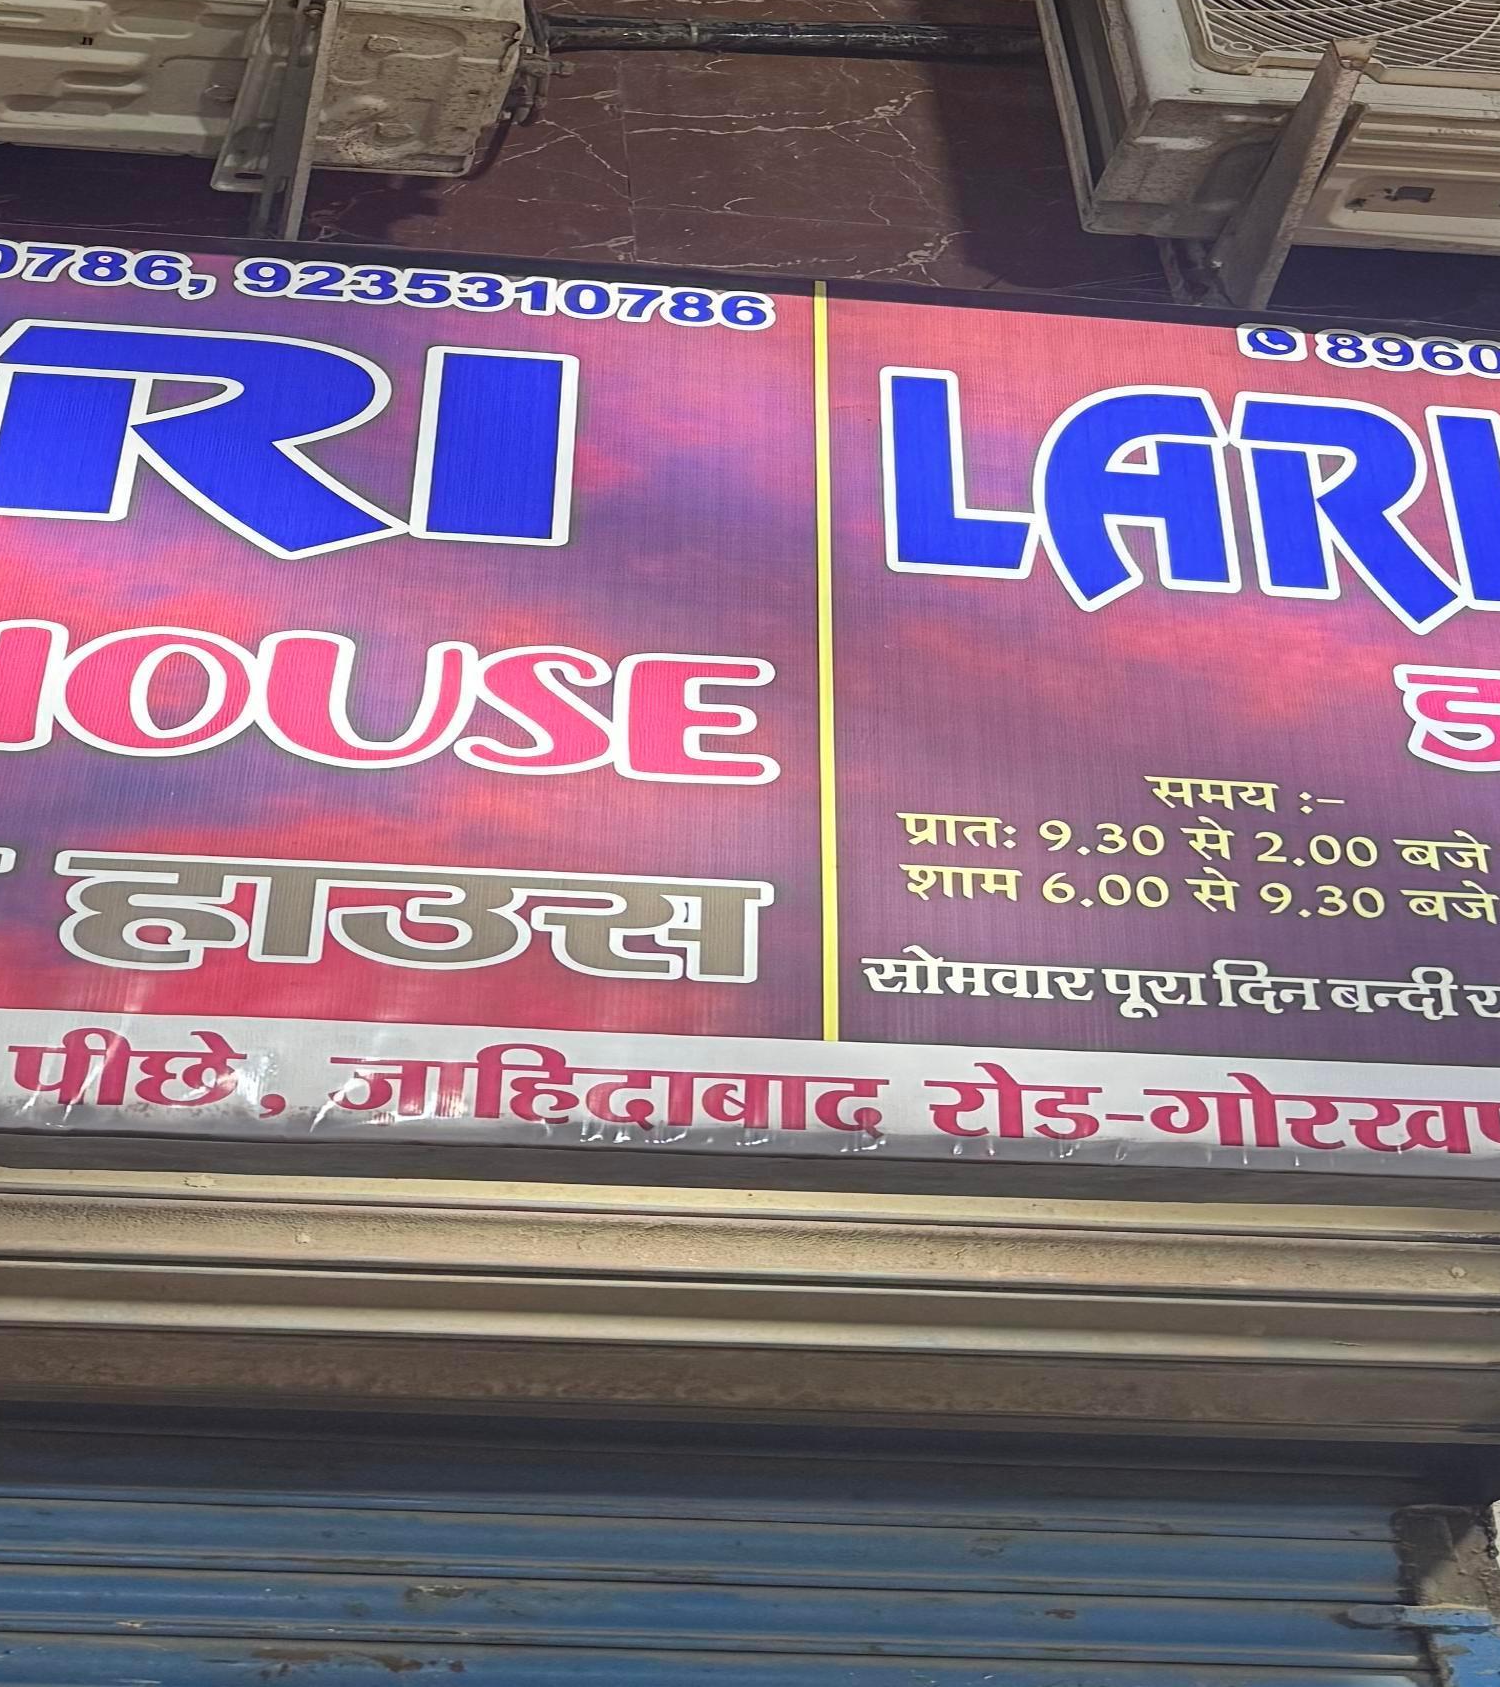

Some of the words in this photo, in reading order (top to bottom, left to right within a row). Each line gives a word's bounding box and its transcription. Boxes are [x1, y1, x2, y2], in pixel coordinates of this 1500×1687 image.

[236, 258, 774, 331] 9235310786
[1145, 774, 1279, 813] समय
[1038, 819, 1167, 858] 9.30
[1179, 816, 1236, 860] से
[1253, 829, 1379, 869] 2.00
[1395, 829, 1492, 874] बजे
[54, 851, 774, 983] हाउस
[899, 862, 1021, 904] शाम
[1041, 870, 1171, 910] 6.00
[1185, 864, 1242, 914] से
[1257, 880, 1387, 923] 9.30
[1404, 881, 1500, 927] बजे
[861, 945, 1096, 1006] सोमवार
[1102, 968, 1208, 1020] पूरा
[1213, 958, 1321, 1018] दिन
[1330, 966, 1460, 1023] बन्दी
[9, 1027, 288, 1119] पीछे,
[329, 1042, 890, 1136] जाहिदाबाद
